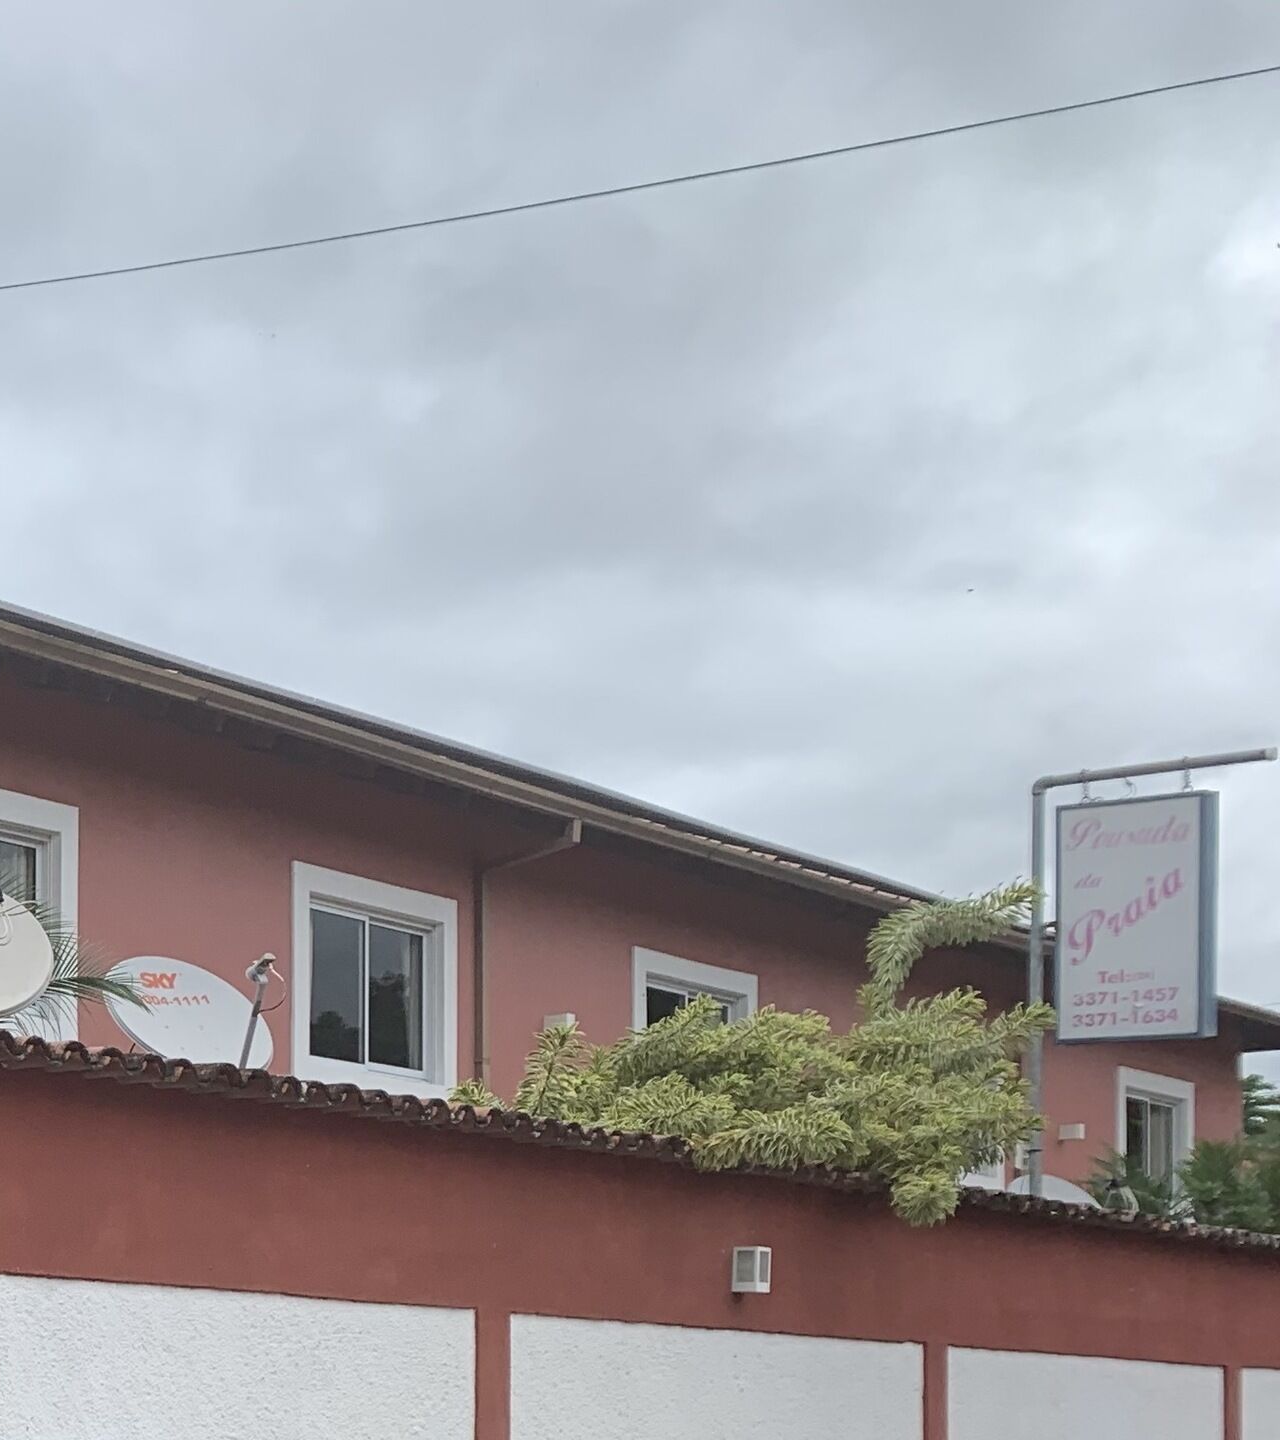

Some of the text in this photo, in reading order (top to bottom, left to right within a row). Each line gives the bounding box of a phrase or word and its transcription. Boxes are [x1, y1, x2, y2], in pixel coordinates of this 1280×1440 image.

[1068, 867, 1184, 966] Praia
[140, 972, 177, 989] SKY
[1073, 986, 1180, 1006] 3371-1457
[1072, 1008, 1179, 1028] 3371-1634
